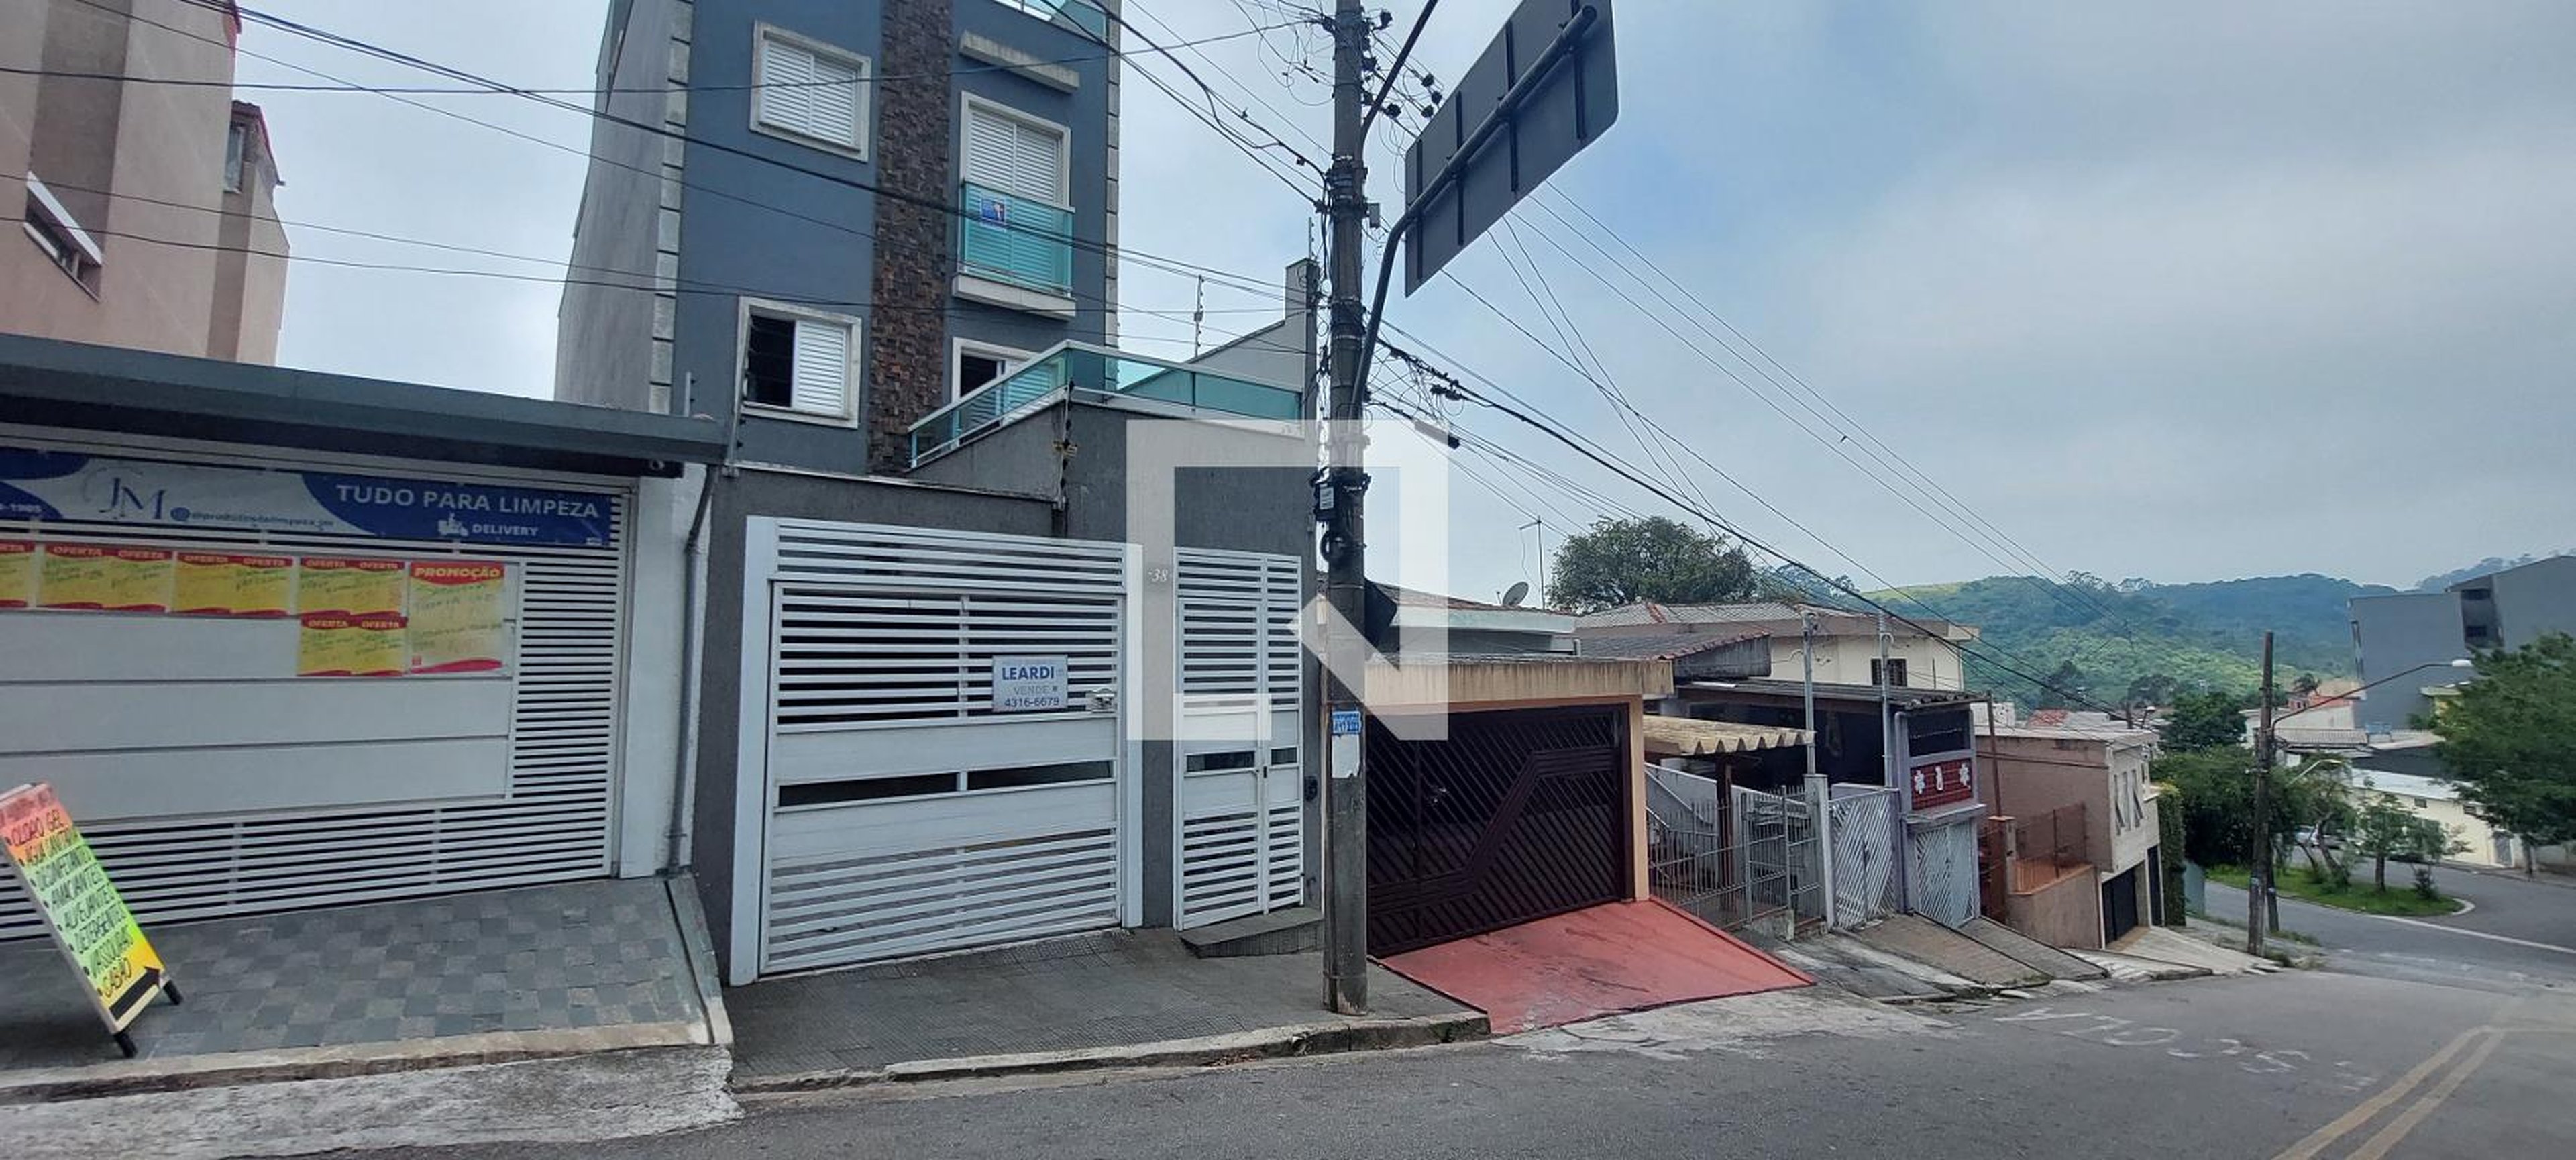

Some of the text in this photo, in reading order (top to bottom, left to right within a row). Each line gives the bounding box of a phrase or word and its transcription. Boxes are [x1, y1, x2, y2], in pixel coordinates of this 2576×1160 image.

[337, 484, 600, 519] TUDO PARA LIMPEZA
[472, 523, 539, 536] DELIVERY
[53, 545, 166, 560] OFERTA OFERTA
[184, 554, 286, 566] OFERTA OFERTA
[305, 559, 399, 570] OFERTA OFERTA
[414, 566, 502, 581] PROMOÇÃO
[308, 619, 400, 629] OFERTA OFERTA
[1002, 666, 1055, 680] LEARDI
[1013, 684, 1051, 696] VENDE
